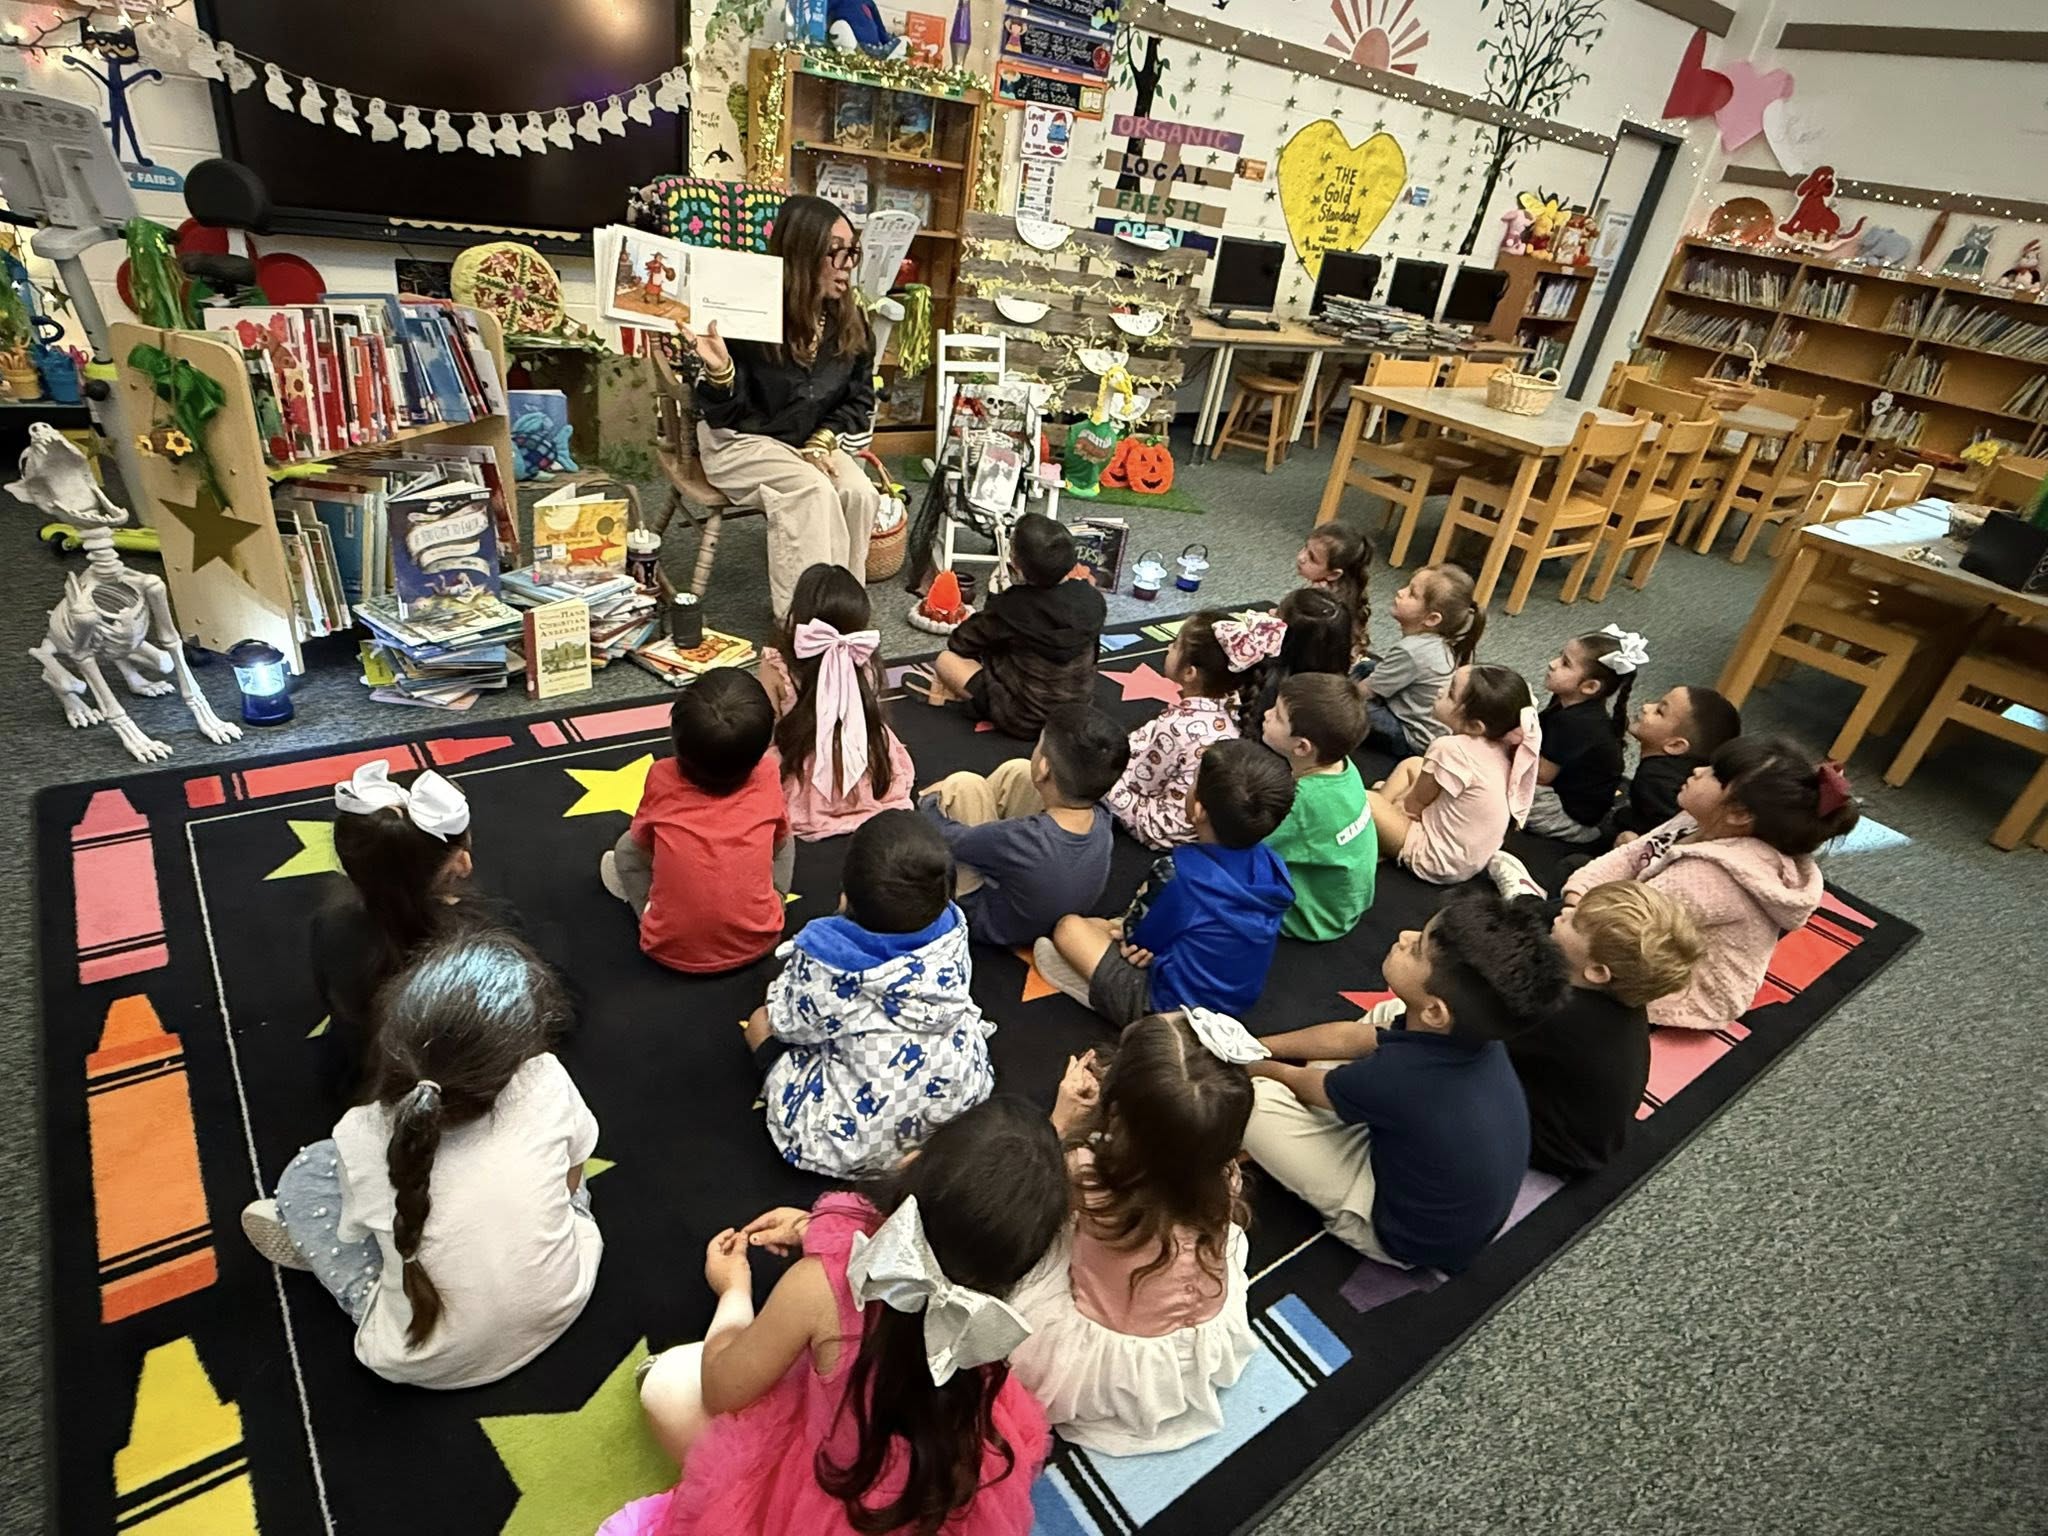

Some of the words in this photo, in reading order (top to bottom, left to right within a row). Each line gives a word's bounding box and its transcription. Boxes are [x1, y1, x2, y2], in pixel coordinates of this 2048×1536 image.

[1027, 110, 1046, 121] Level
[1118, 112, 1230, 149] ORGANIC
[137, 172, 176, 186] FAIRS
[1121, 153, 1208, 185] LOCAL
[1335, 166, 1358, 186] THE
[1324, 183, 1352, 205] Gold
[1116, 192, 1202, 222] FRESH
[1318, 204, 1360, 224] Standard
